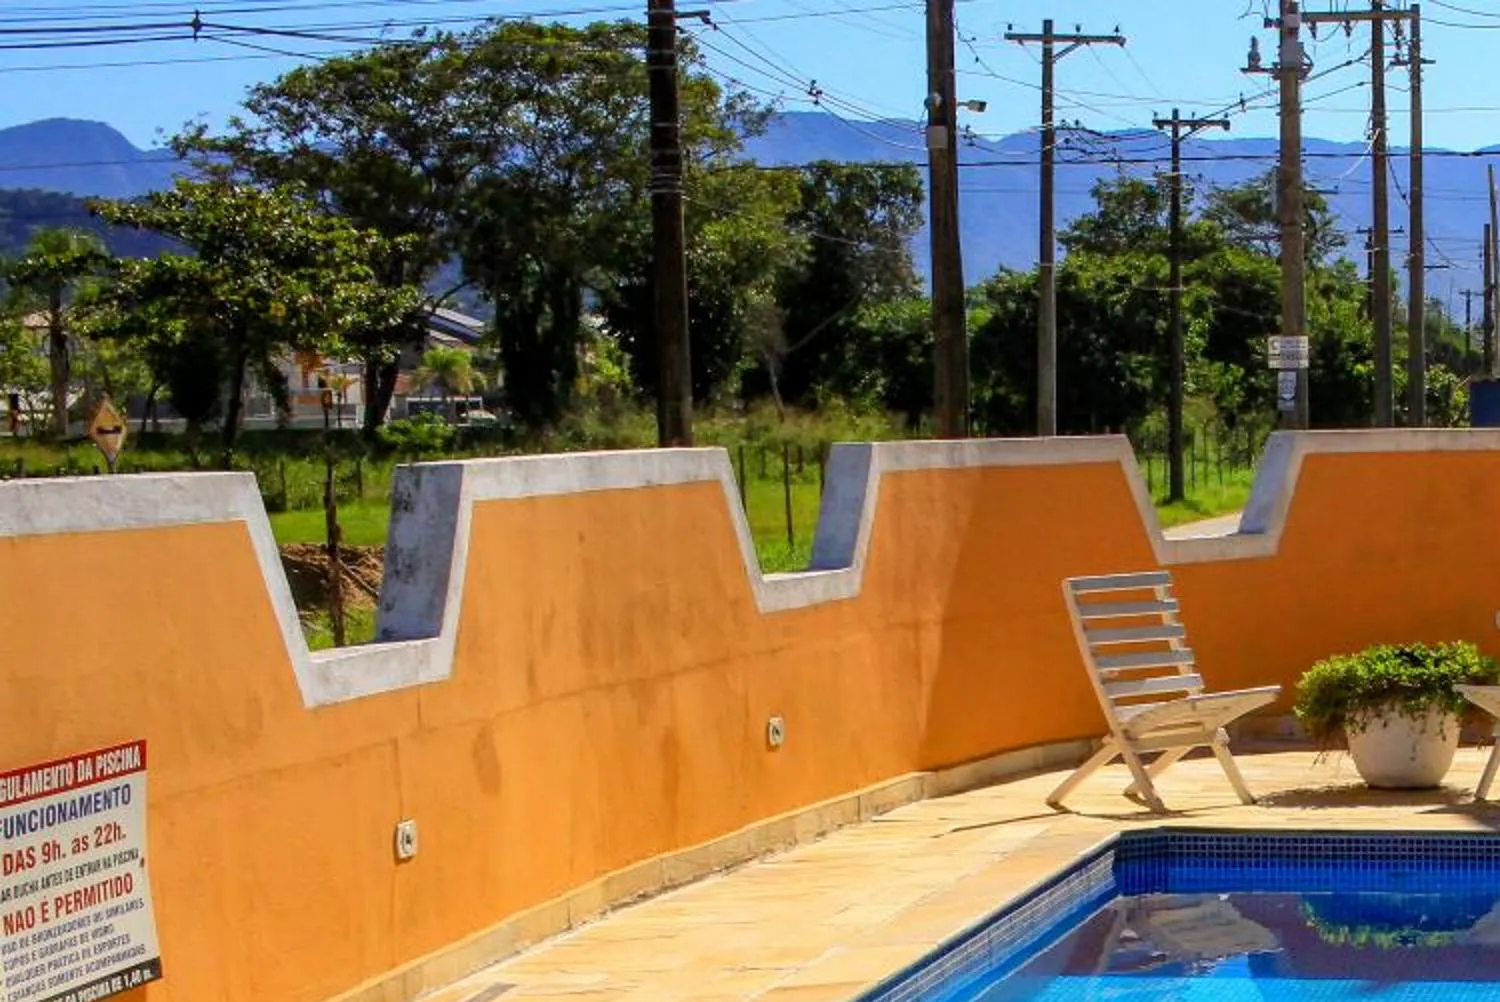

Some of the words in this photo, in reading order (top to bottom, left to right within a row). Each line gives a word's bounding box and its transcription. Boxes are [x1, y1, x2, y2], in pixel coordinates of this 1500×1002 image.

[77, 757, 93, 782] DA
[96, 745, 141, 777] PISCINA
[3, 846, 36, 876] DAS
[42, 839, 66, 865] 9h.
[94, 821, 126, 848] 22h.
[41, 870, 63, 889] ANTES
[64, 867, 74, 882] DE
[113, 848, 139, 867] PISCINA
[54, 872, 133, 918] PERMITIDO
